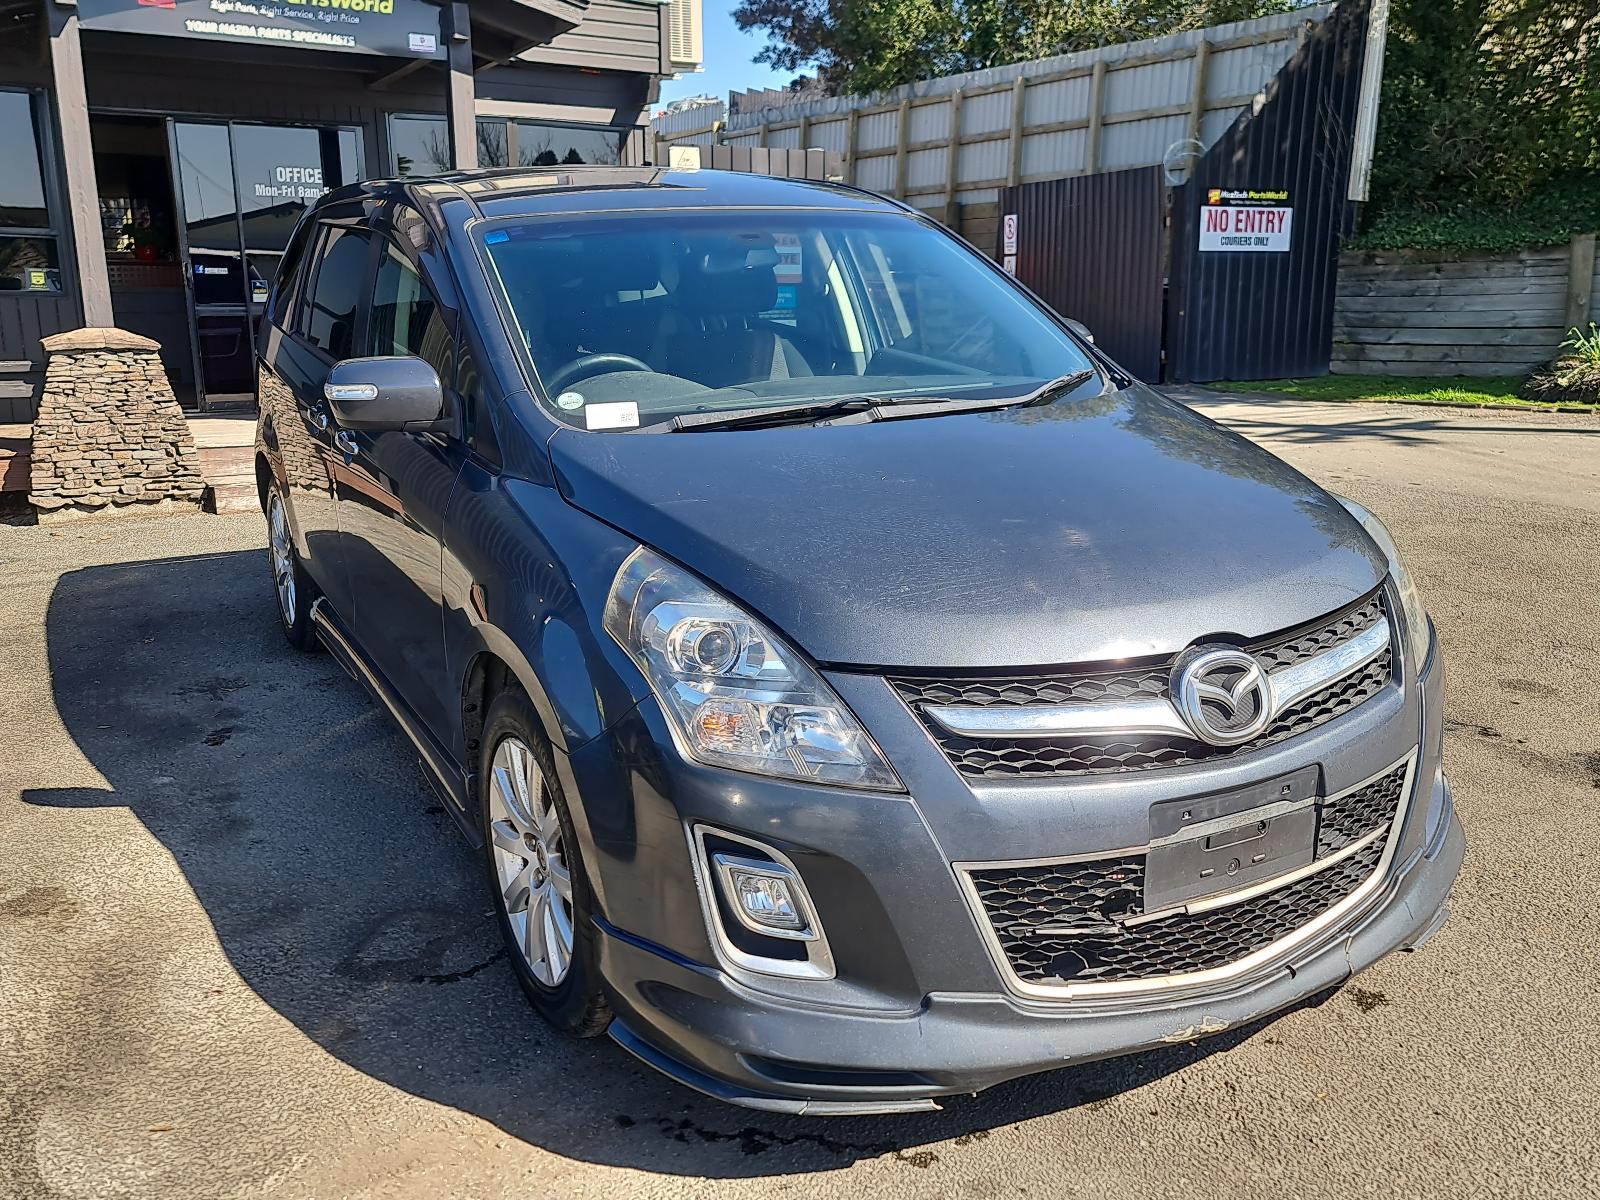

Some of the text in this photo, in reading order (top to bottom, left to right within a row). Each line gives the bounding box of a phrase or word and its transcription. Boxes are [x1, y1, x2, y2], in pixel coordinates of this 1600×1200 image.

[340, 13, 360, 24] Price
[186, 20, 355, 46] YOUR MAZDA PARTS SPECIALISTS
[276, 166, 323, 184] OFFICE
[1206, 209, 1286, 233] NO ENTRY
[1220, 236, 1269, 246] COURIERS ONLY
